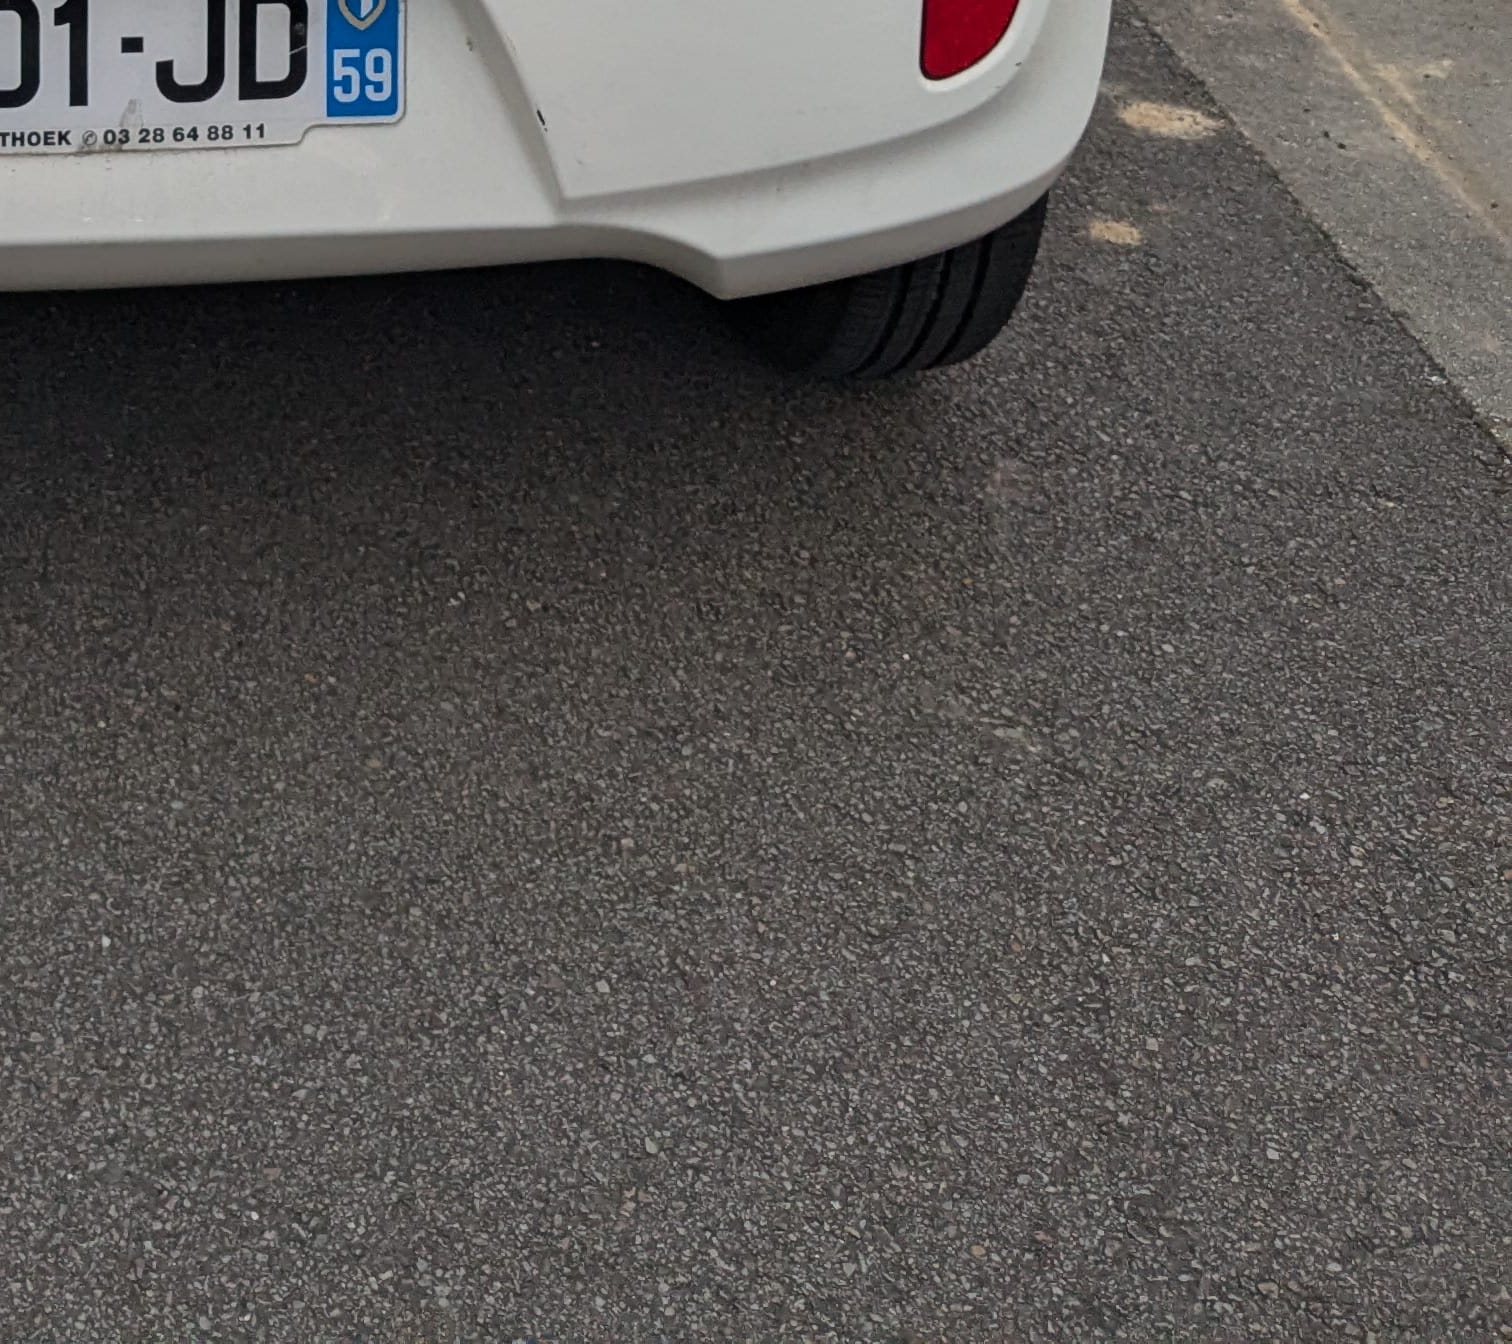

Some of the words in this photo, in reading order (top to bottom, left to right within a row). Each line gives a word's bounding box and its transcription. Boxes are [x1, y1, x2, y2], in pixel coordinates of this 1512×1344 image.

[333, 48, 392, 103] 59
[103, 129, 130, 145] 03
[138, 127, 165, 143] 28
[172, 126, 199, 142] 64
[207, 124, 234, 141] 88
[243, 123, 266, 139] 11
